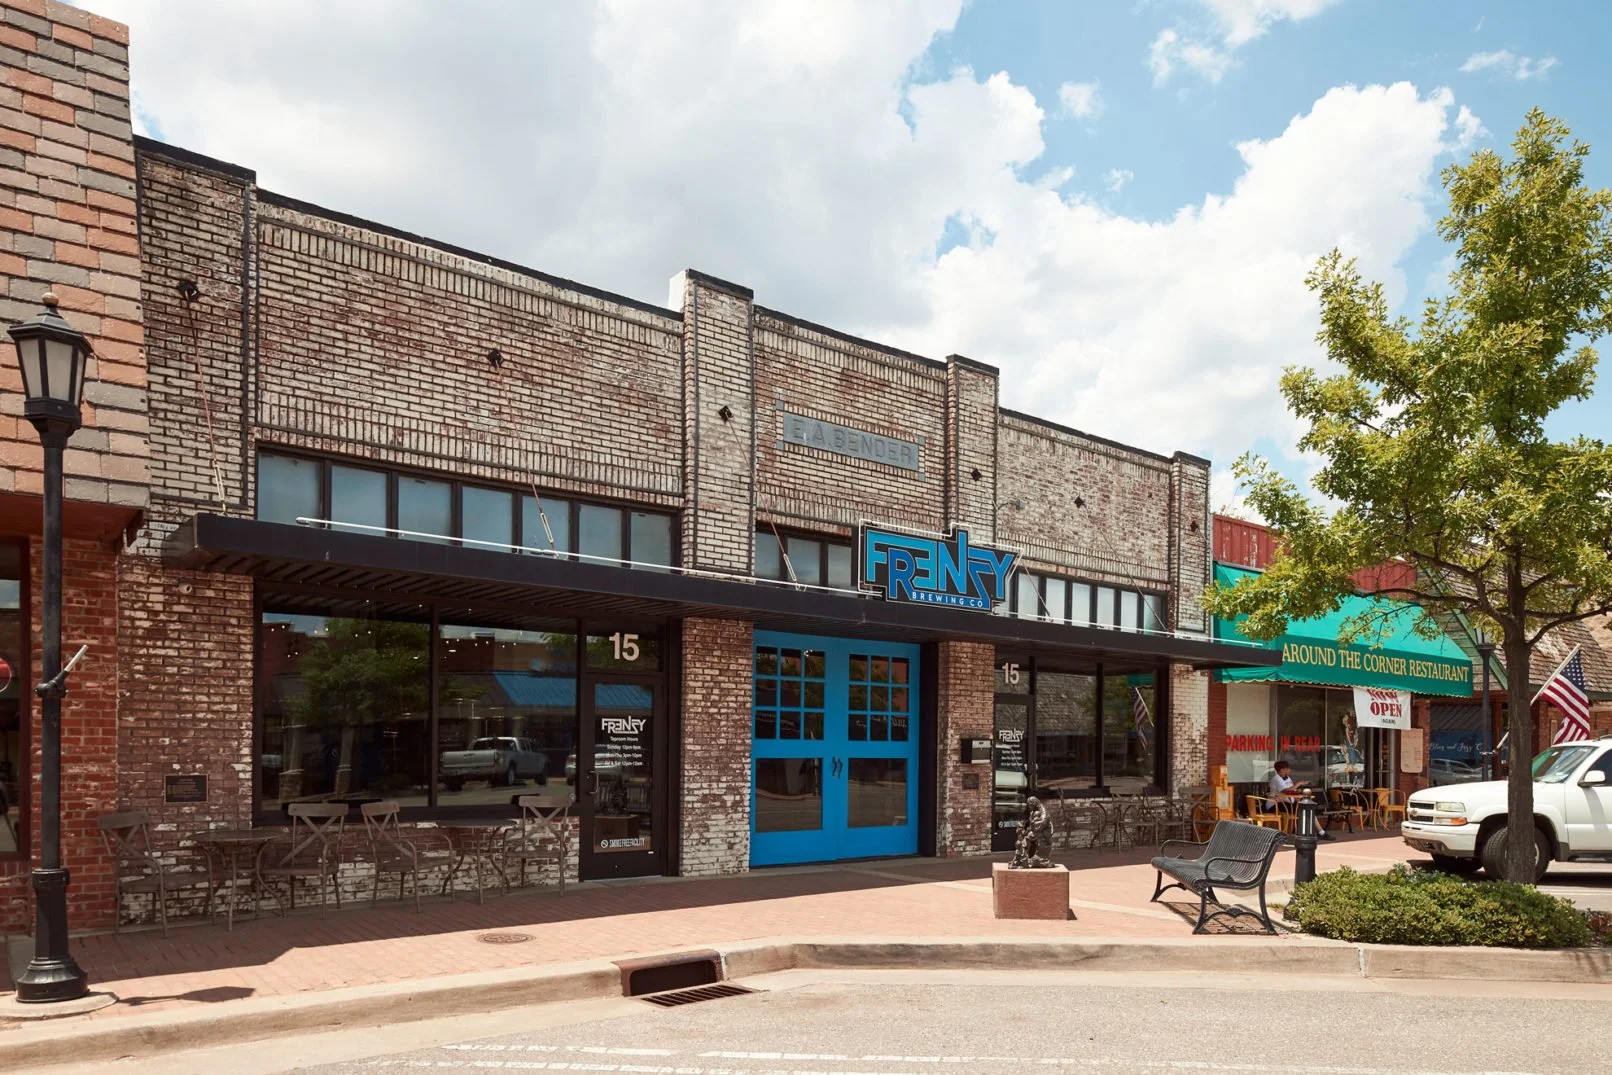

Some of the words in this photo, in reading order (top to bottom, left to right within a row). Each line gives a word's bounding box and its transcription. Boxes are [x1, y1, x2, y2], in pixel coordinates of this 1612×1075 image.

[833, 428, 913, 465] BENDER
[866, 529, 1015, 610] FRENZY
[911, 591, 965, 606] BREWING
[969, 598, 984, 608] CO
[608, 632, 640, 661] 15
[1001, 662, 1020, 684] 15
[1282, 643, 1337, 667] AROUND
[1338, 650, 1361, 669] THE
[1363, 654, 1408, 676] CORNER
[1409, 660, 1470, 683] RESTAURANT
[1370, 702, 1402, 718] OPEN
[601, 715, 647, 734] FRENZY
[998, 728, 1025, 742] FRENZY
[1226, 735, 1274, 753] PARKING
[1280, 735, 1292, 753] IN
[1294, 735, 1321, 753] REAR
